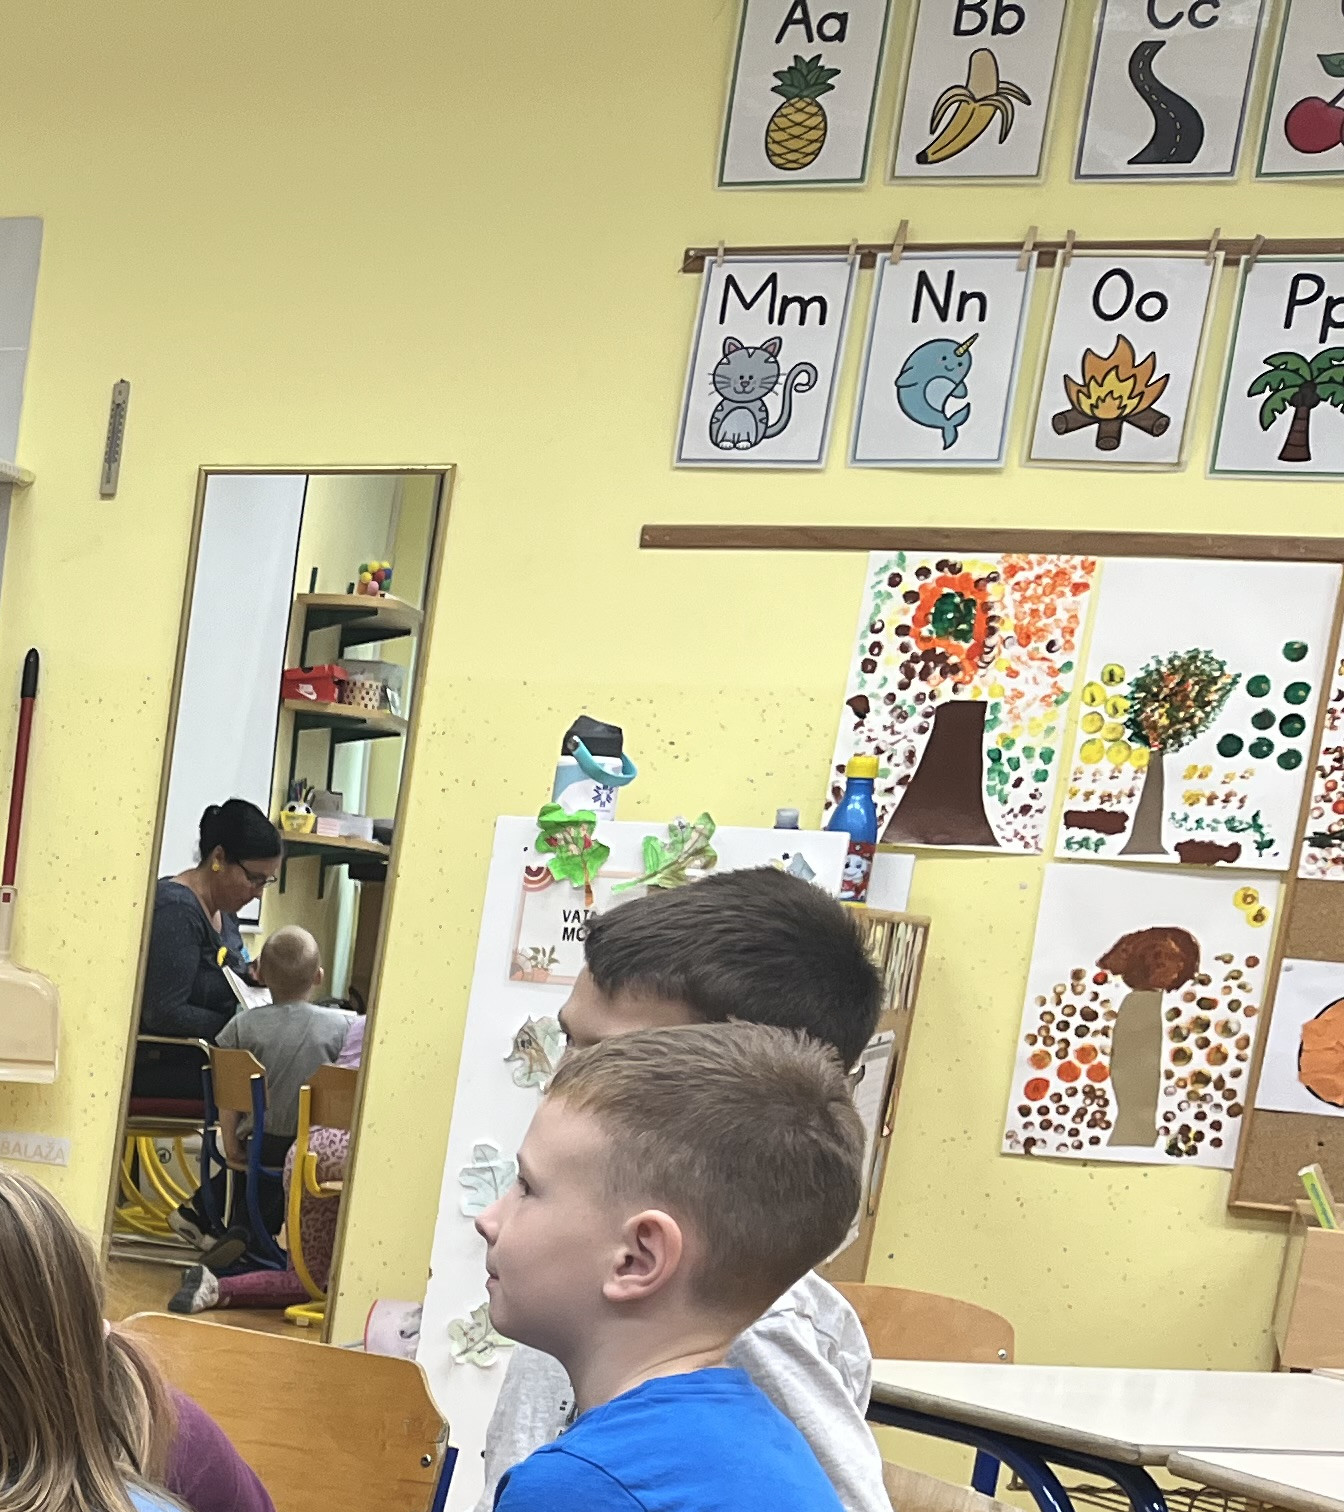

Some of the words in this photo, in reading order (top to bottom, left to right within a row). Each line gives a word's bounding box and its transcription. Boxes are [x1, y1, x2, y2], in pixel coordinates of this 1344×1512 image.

[774, 0, 850, 44] Aa
[952, 0, 1026, 38] Bb
[1145, 0, 1221, 30] Cc
[718, 271, 828, 327] Mm
[911, 269, 989, 324] Nn
[1092, 267, 1170, 323] Oo
[1282, 272, 1344, 344] Pp
